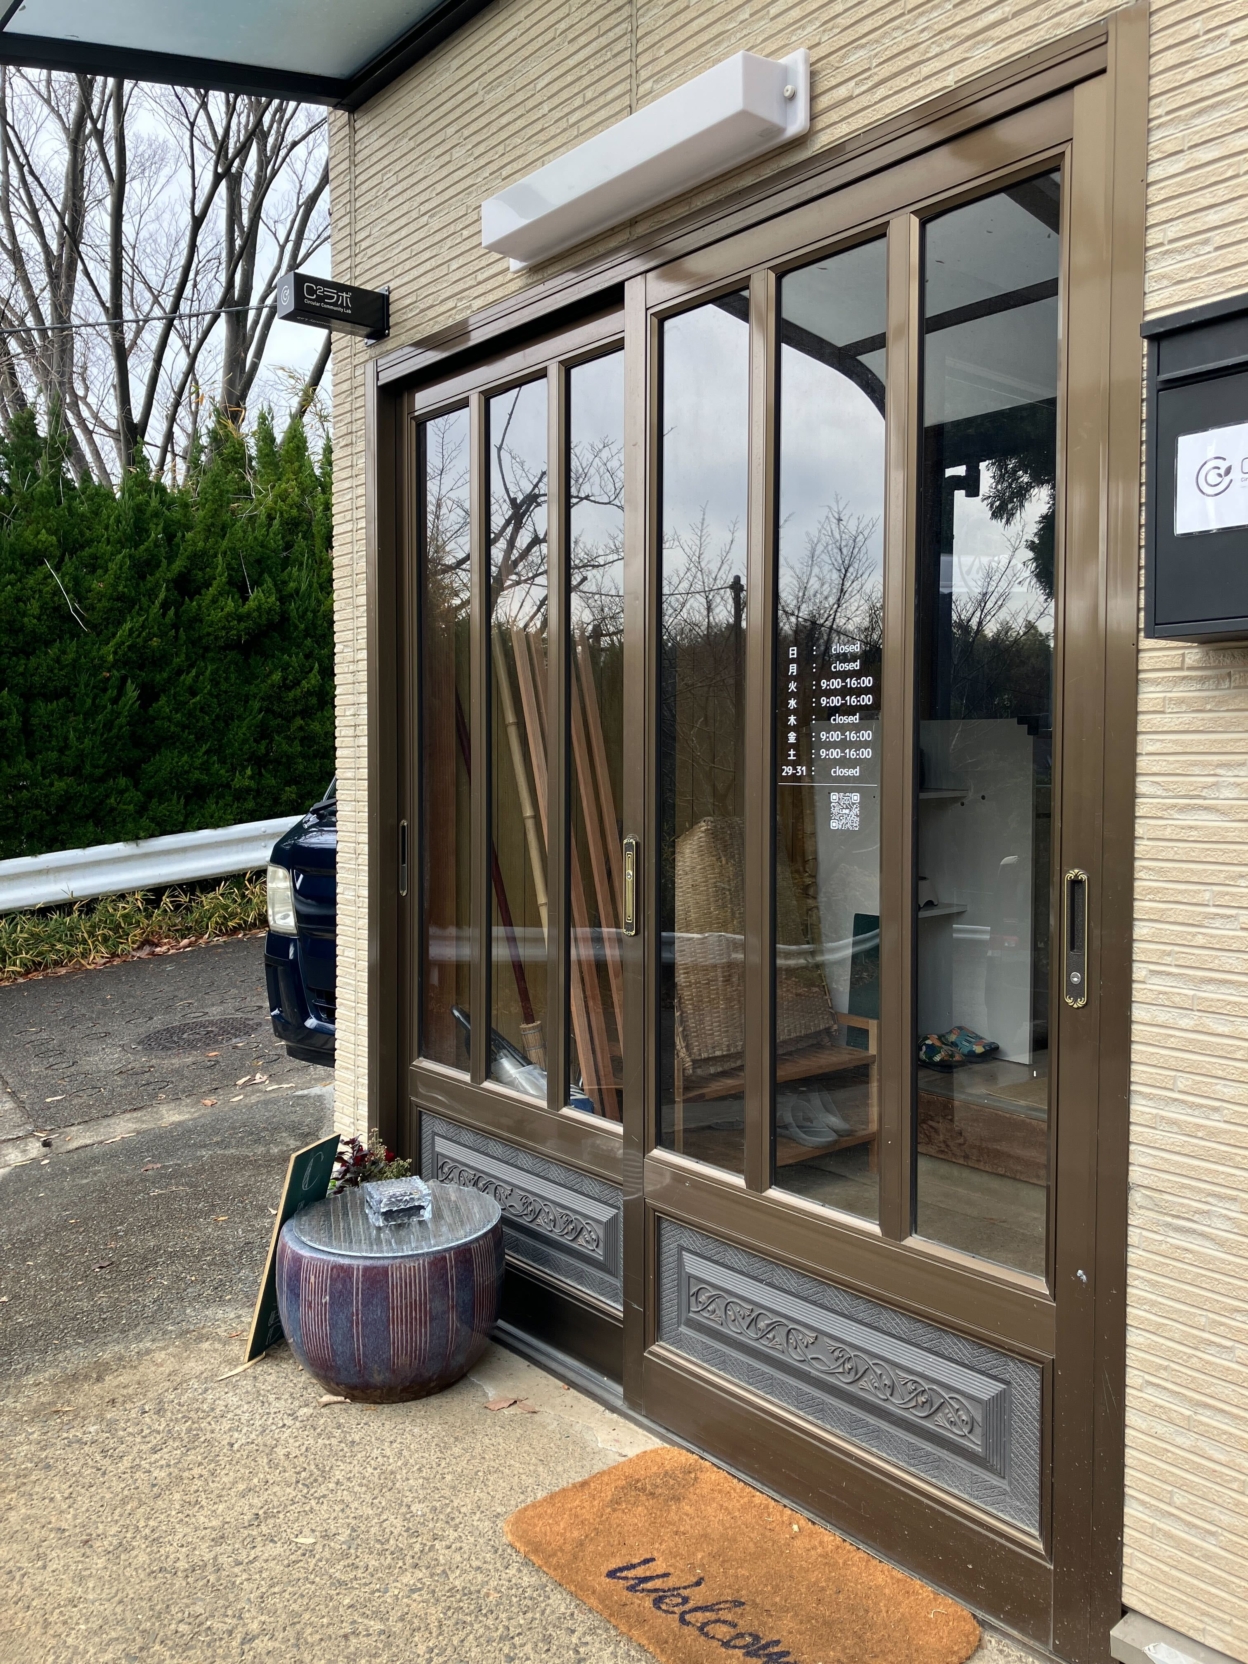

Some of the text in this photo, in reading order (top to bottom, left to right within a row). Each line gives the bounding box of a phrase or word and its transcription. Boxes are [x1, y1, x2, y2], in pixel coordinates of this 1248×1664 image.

[304, 298, 320, 306] Circular
[321, 302, 343, 313] Community
[788, 646, 797, 659] 日
[831, 641, 860, 653] closed
[788, 663, 797, 676] 月
[831, 659, 860, 671] closed
[788, 680, 797, 692] 火
[820, 677, 873, 690] 9:00-16:00
[787, 697, 797, 710] 水
[820, 694, 873, 707] 9:00-16:00
[787, 714, 797, 727] 木
[830, 712, 860, 724] closed
[787, 731, 797, 743] 金
[820, 730, 873, 742] 9:00-16:00
[787, 748, 797, 760] 土
[820, 748, 873, 759] 9:00-16:00
[781, 765, 807, 776] 29-31
[830, 765, 860, 776] closed
